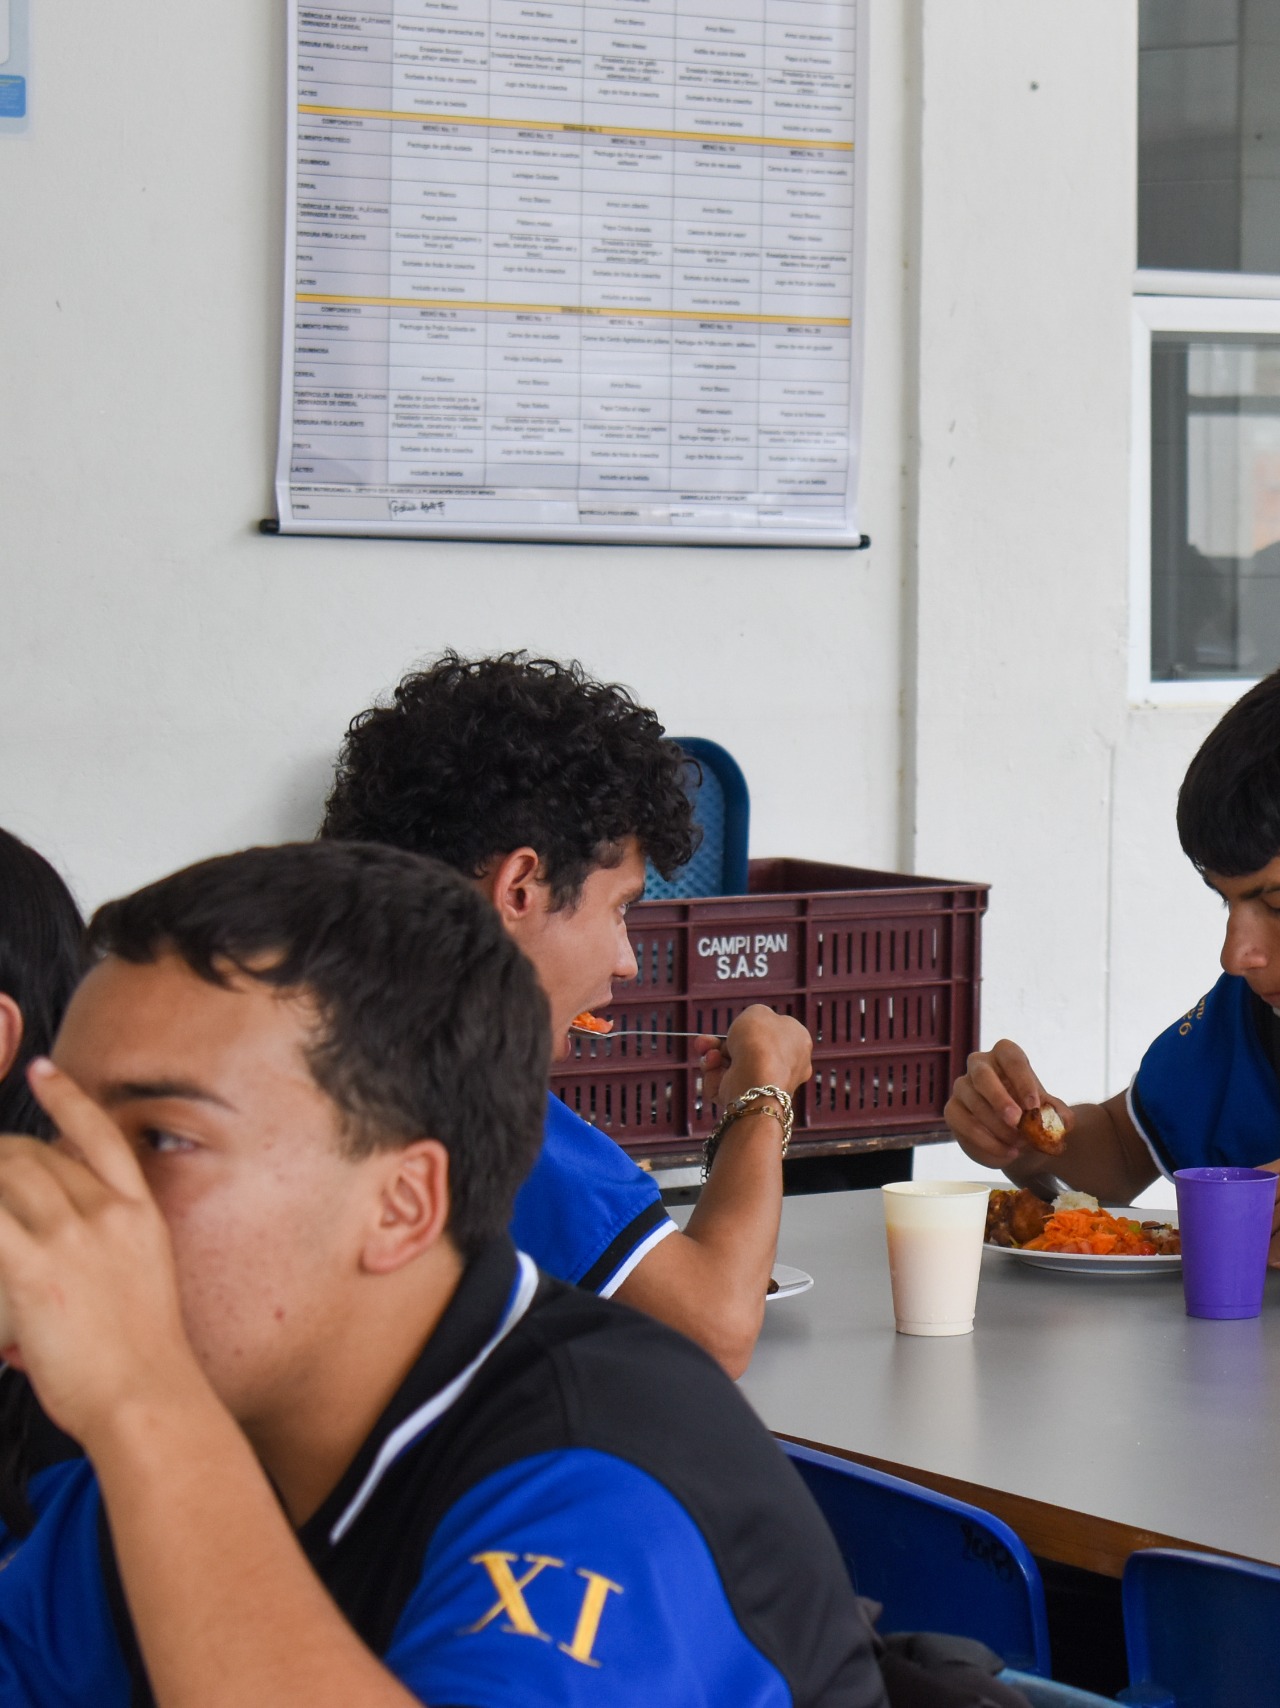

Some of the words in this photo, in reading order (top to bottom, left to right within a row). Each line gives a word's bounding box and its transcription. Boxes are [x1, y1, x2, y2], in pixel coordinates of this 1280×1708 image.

[698, 936, 750, 957] CAMPI
[754, 933, 788, 953] PAN
[716, 953, 769, 979] S.A.S
[457, 1551, 625, 1668] XI
